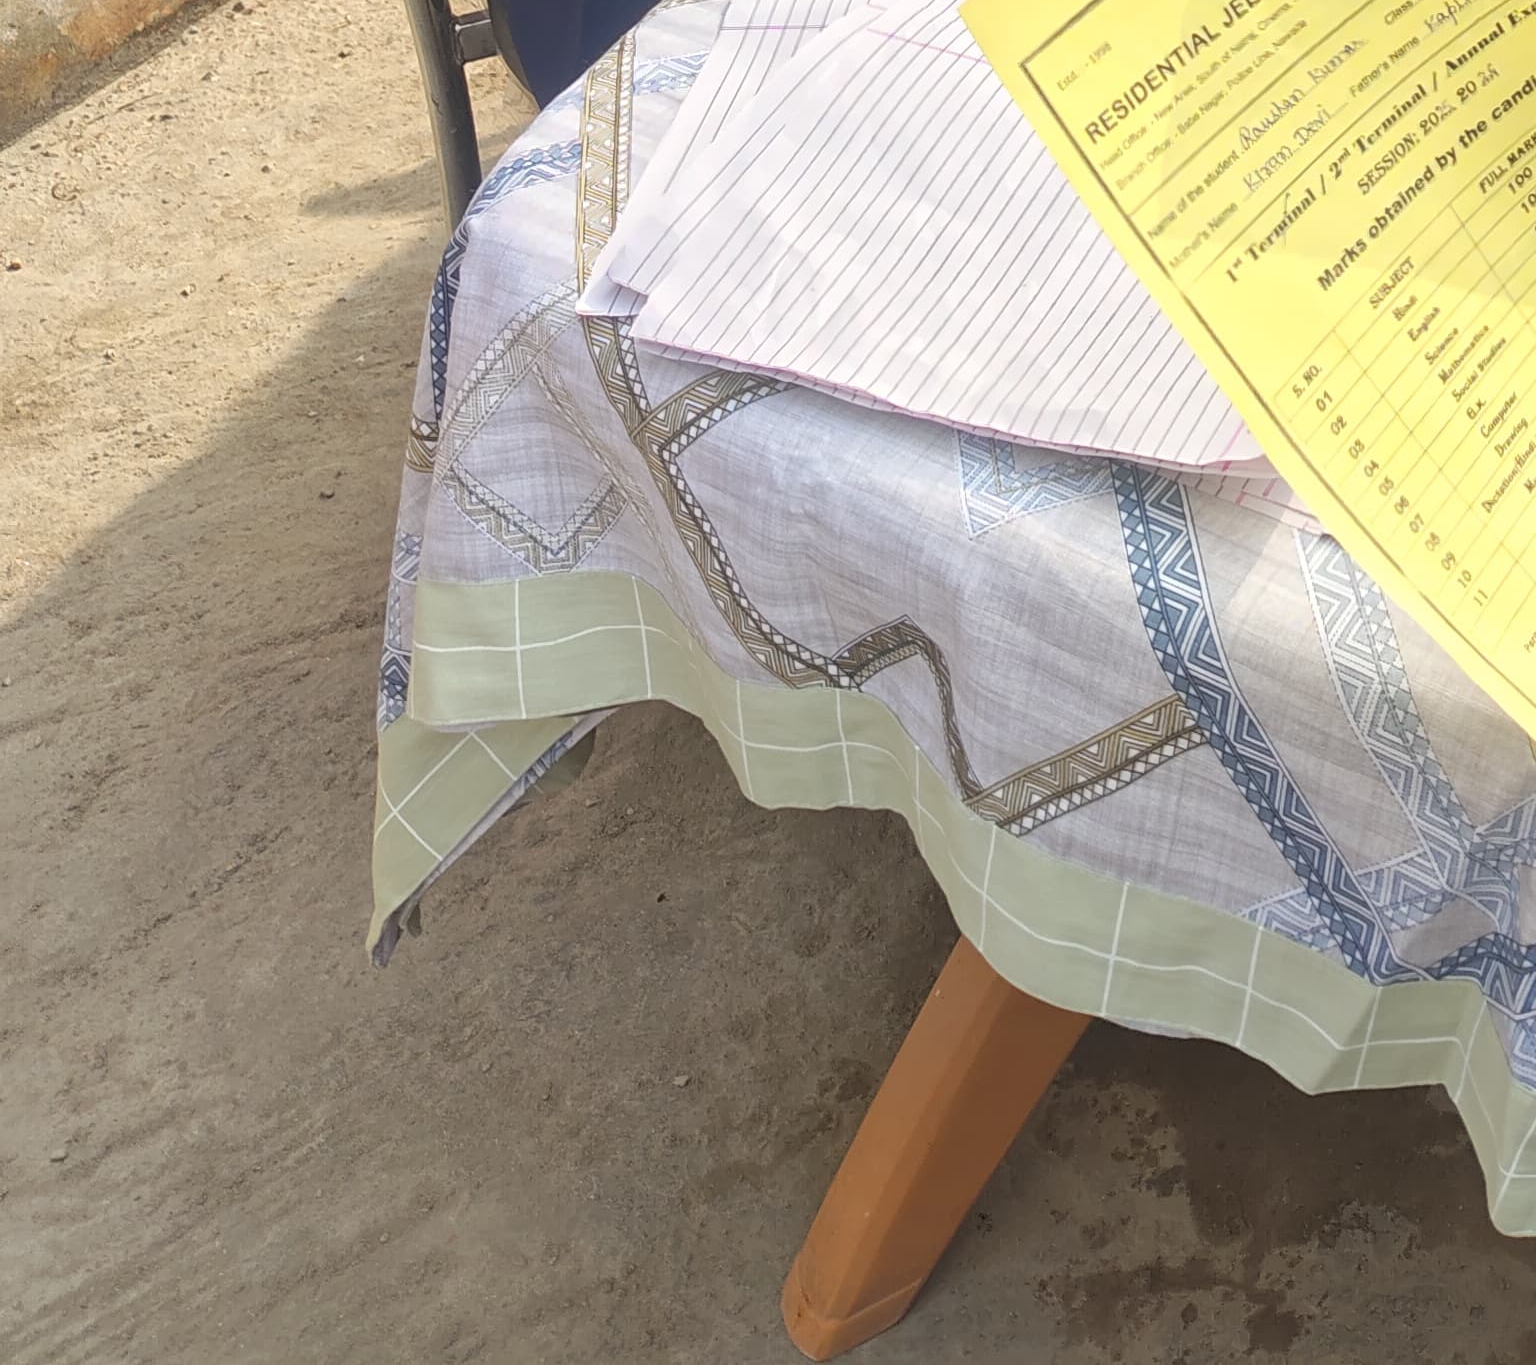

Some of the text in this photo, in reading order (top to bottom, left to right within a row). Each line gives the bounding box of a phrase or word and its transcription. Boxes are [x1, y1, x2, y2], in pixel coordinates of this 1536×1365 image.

[1082, 17, 1222, 146] RESIDENTIAL
[1204, 198, 1240, 233] Name
[1346, 56, 1392, 99] Father's
[1387, 32, 1421, 64] Name
[1241, 186, 1319, 265] Terminal
[1350, 81, 1428, 157] Terminal
[1440, 19, 1506, 78] Annual
[1354, 127, 1422, 197] SESSION:
[1145, 206, 1179, 241] Name
[1173, 195, 1191, 215] of
[1183, 180, 1206, 204] the
[1199, 147, 1242, 189] student
[1315, 236, 1370, 293] Marks
[1363, 163, 1437, 242] obtained
[1433, 140, 1463, 174] by
[1456, 114, 1490, 151] the
[1366, 254, 1417, 311] SUBJECT
[1477, 159, 1509, 195] FULL
[1312, 388, 1335, 414] 01
[1505, 163, 1535, 197] 100
[1327, 412, 1349, 438] 02
[1478, 390, 1521, 440] Computer
[1492, 415, 1530, 458] Drawing
[1361, 456, 1381, 480] 04
[1455, 566, 1474, 590] 10
